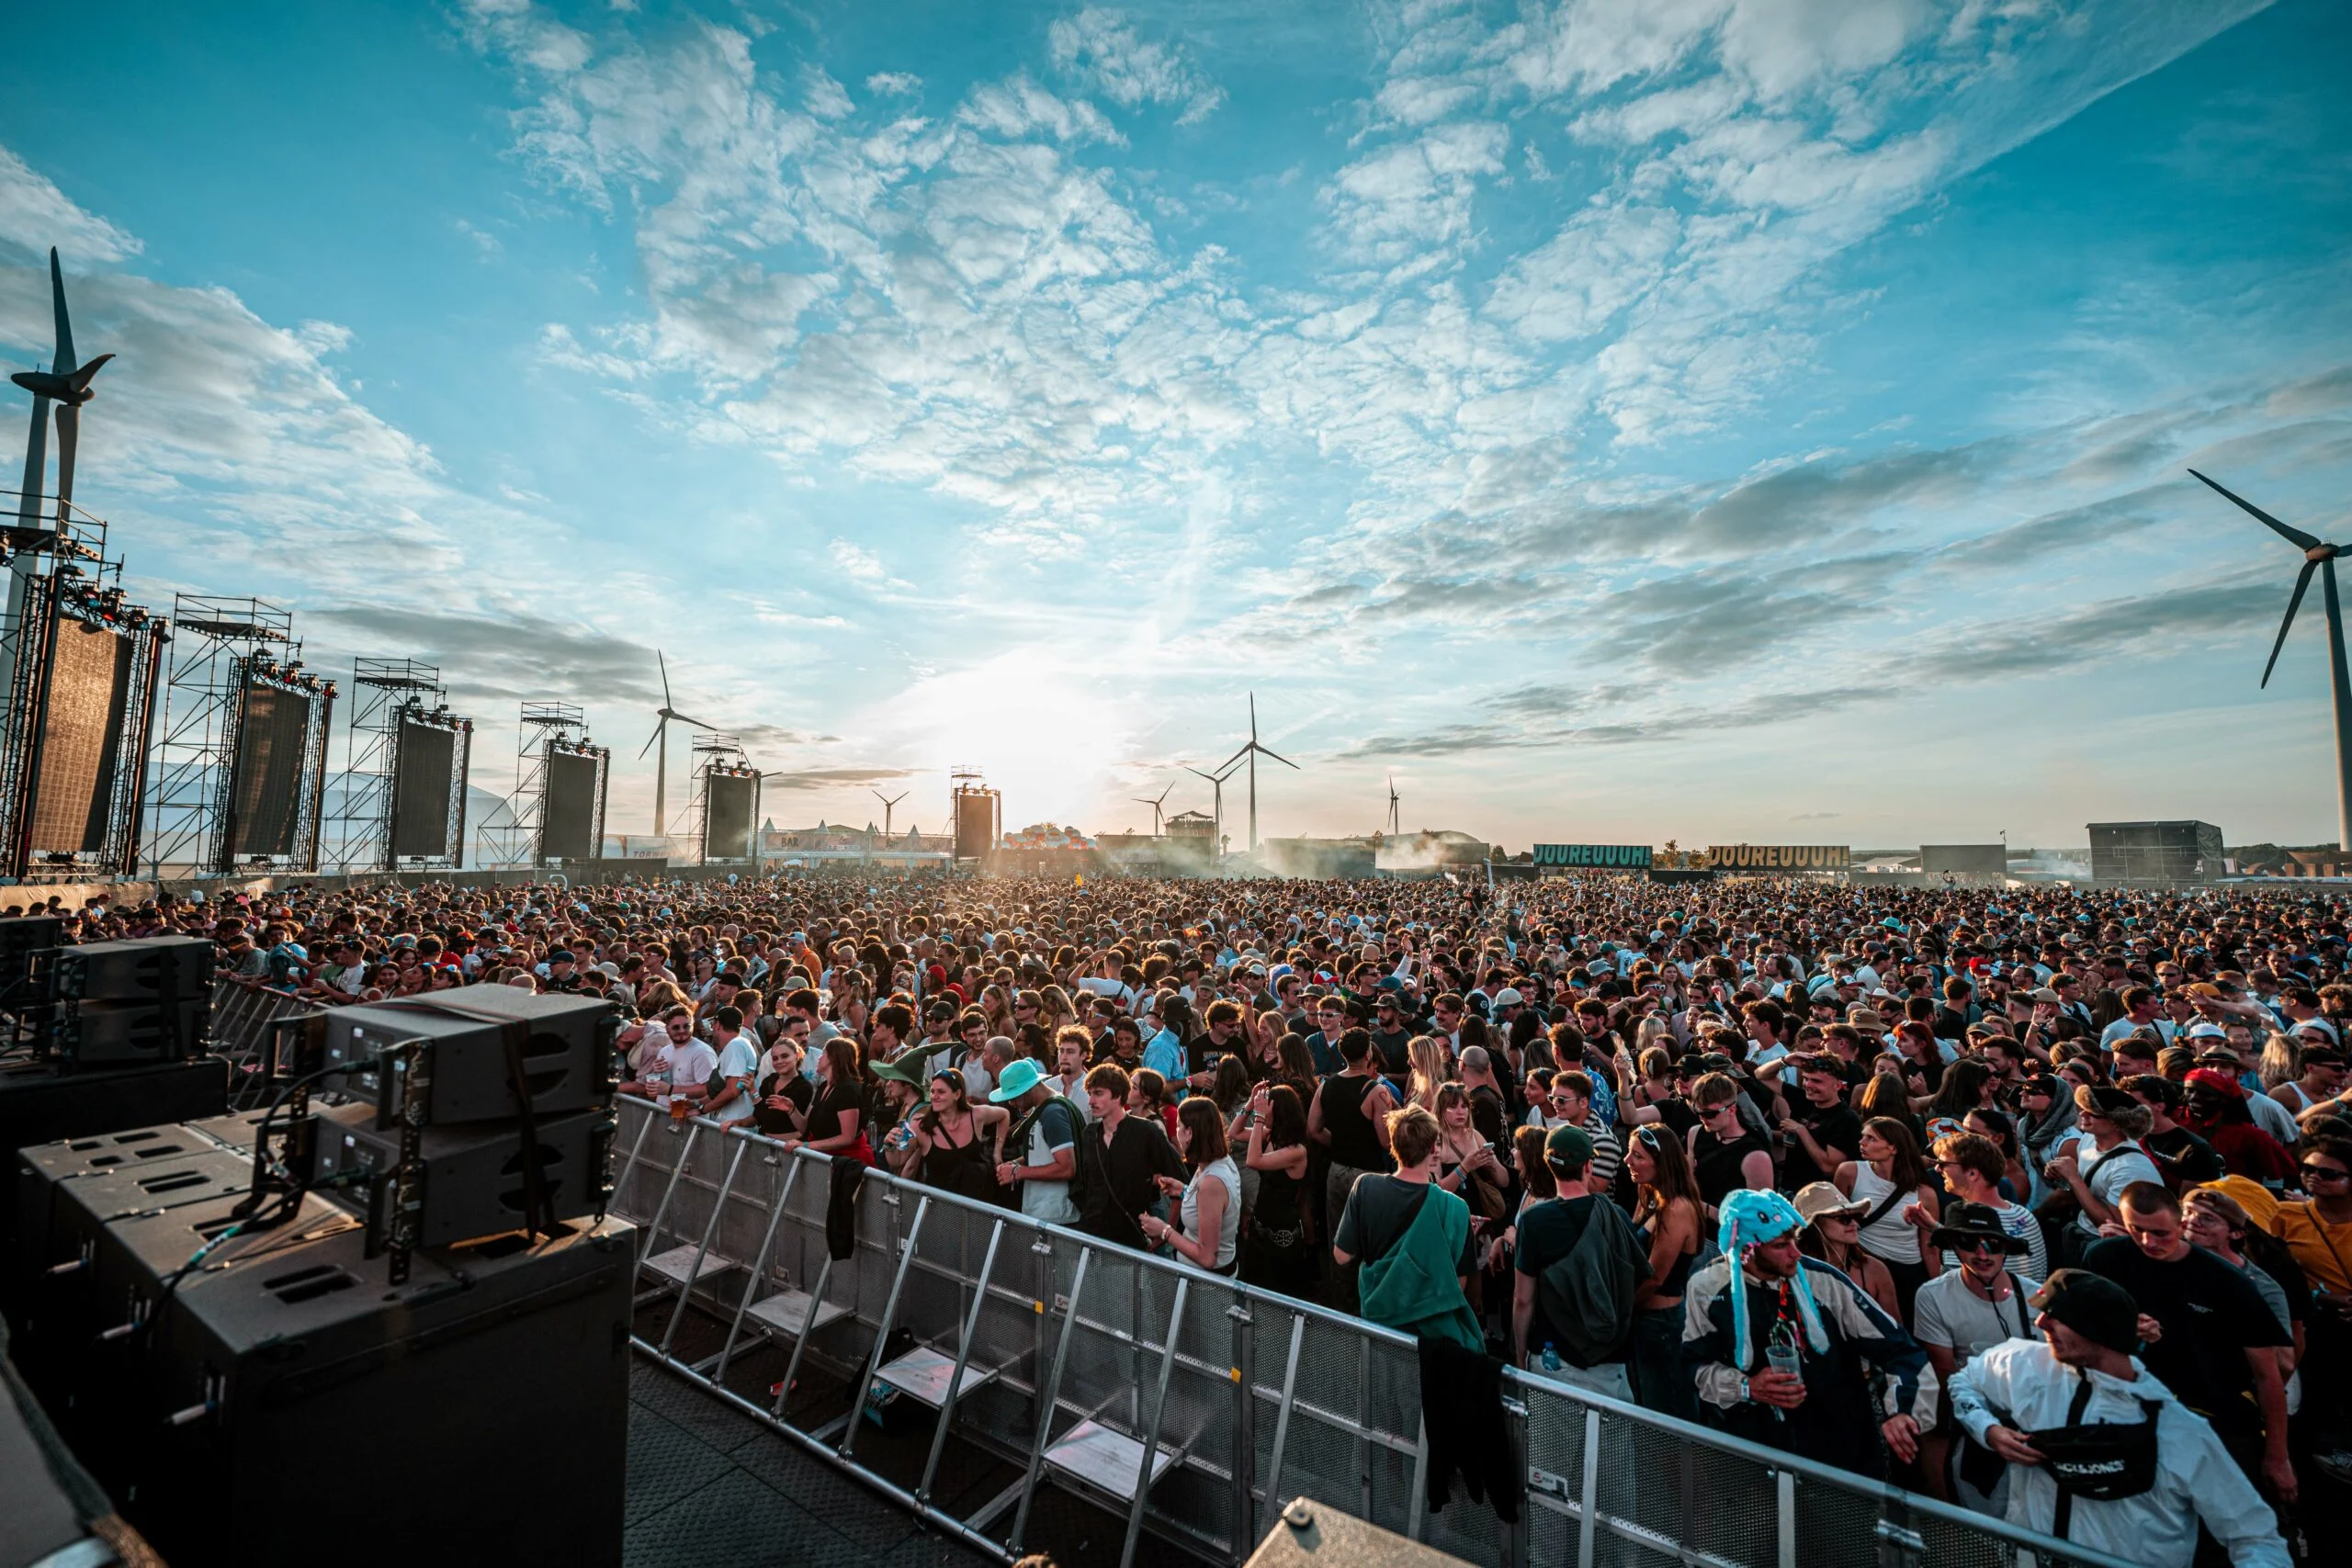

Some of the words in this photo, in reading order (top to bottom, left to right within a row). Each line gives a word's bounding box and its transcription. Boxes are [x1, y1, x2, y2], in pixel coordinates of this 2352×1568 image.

[781, 837, 799, 847] BAR
[1533, 846, 1651, 866] DOUREUUUH!
[1709, 846, 1849, 867] DOUREUUUH!
